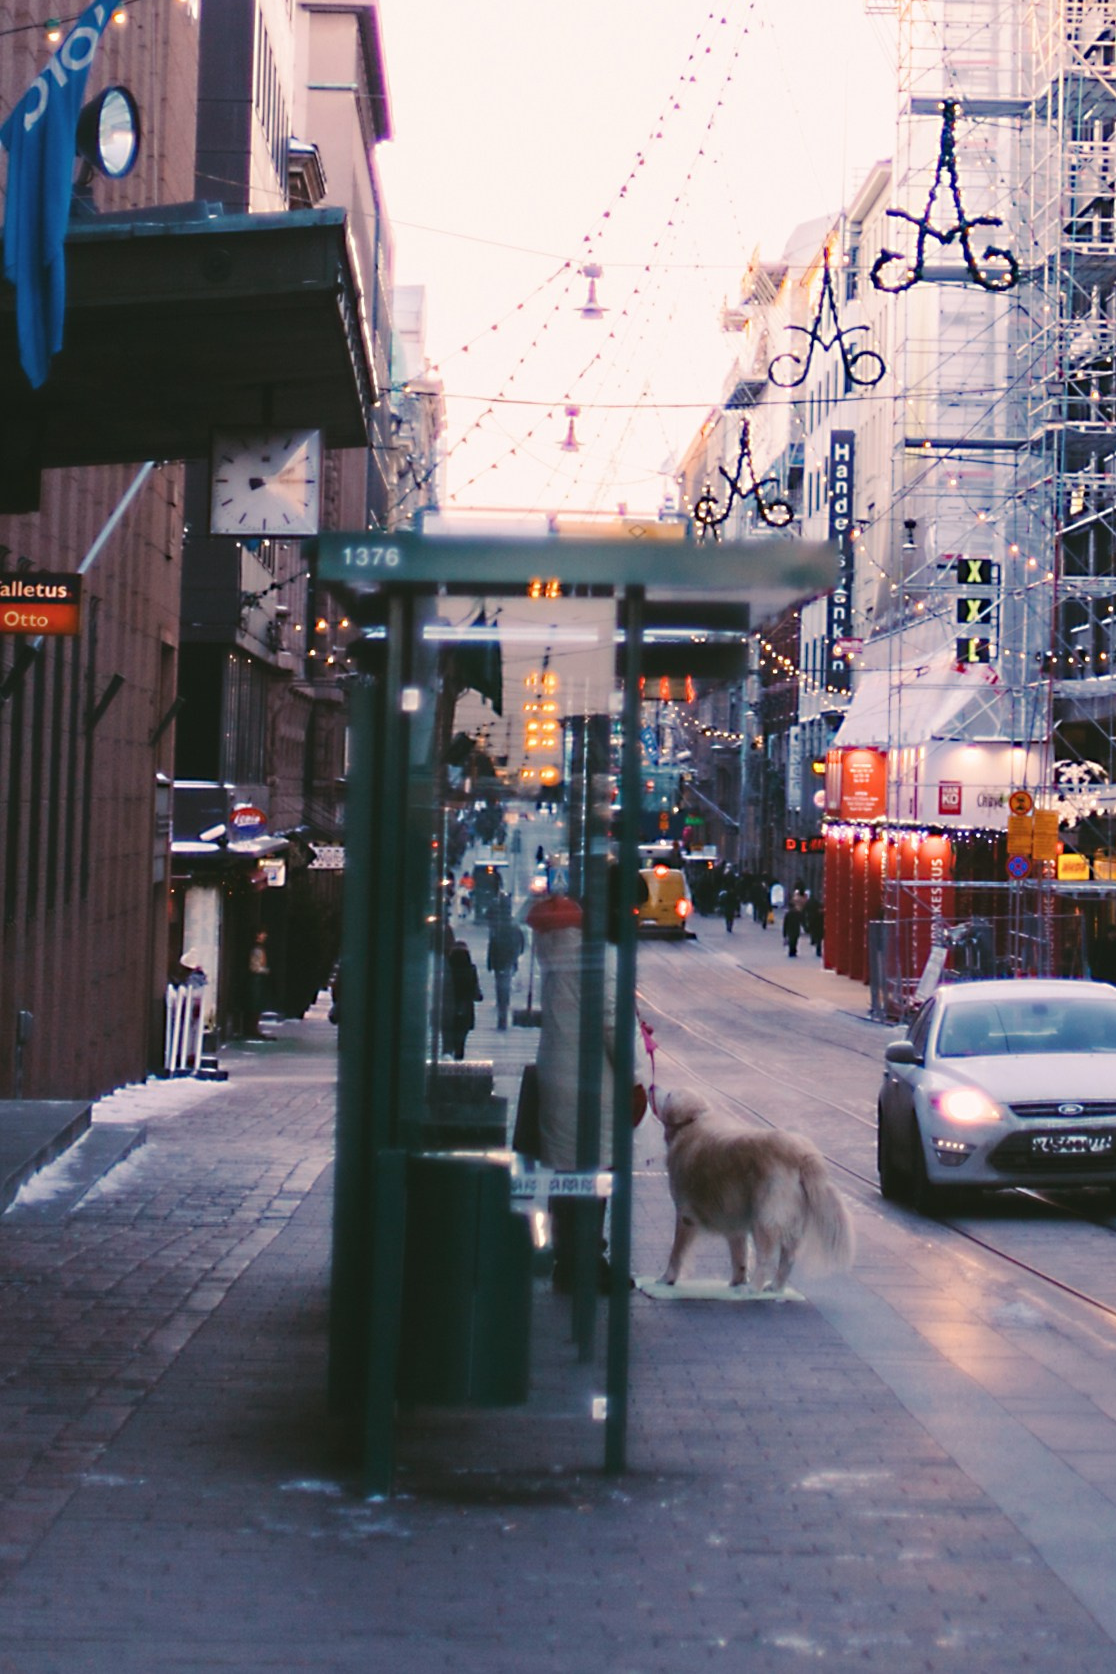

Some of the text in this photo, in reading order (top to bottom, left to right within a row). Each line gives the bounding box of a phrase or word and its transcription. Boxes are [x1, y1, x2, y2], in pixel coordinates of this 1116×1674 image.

[343, 546, 400, 567] 1376
[832, 443, 851, 671] Handelsankn
[4, 610, 49, 627] Otto
[966, 559, 983, 663] XXL
